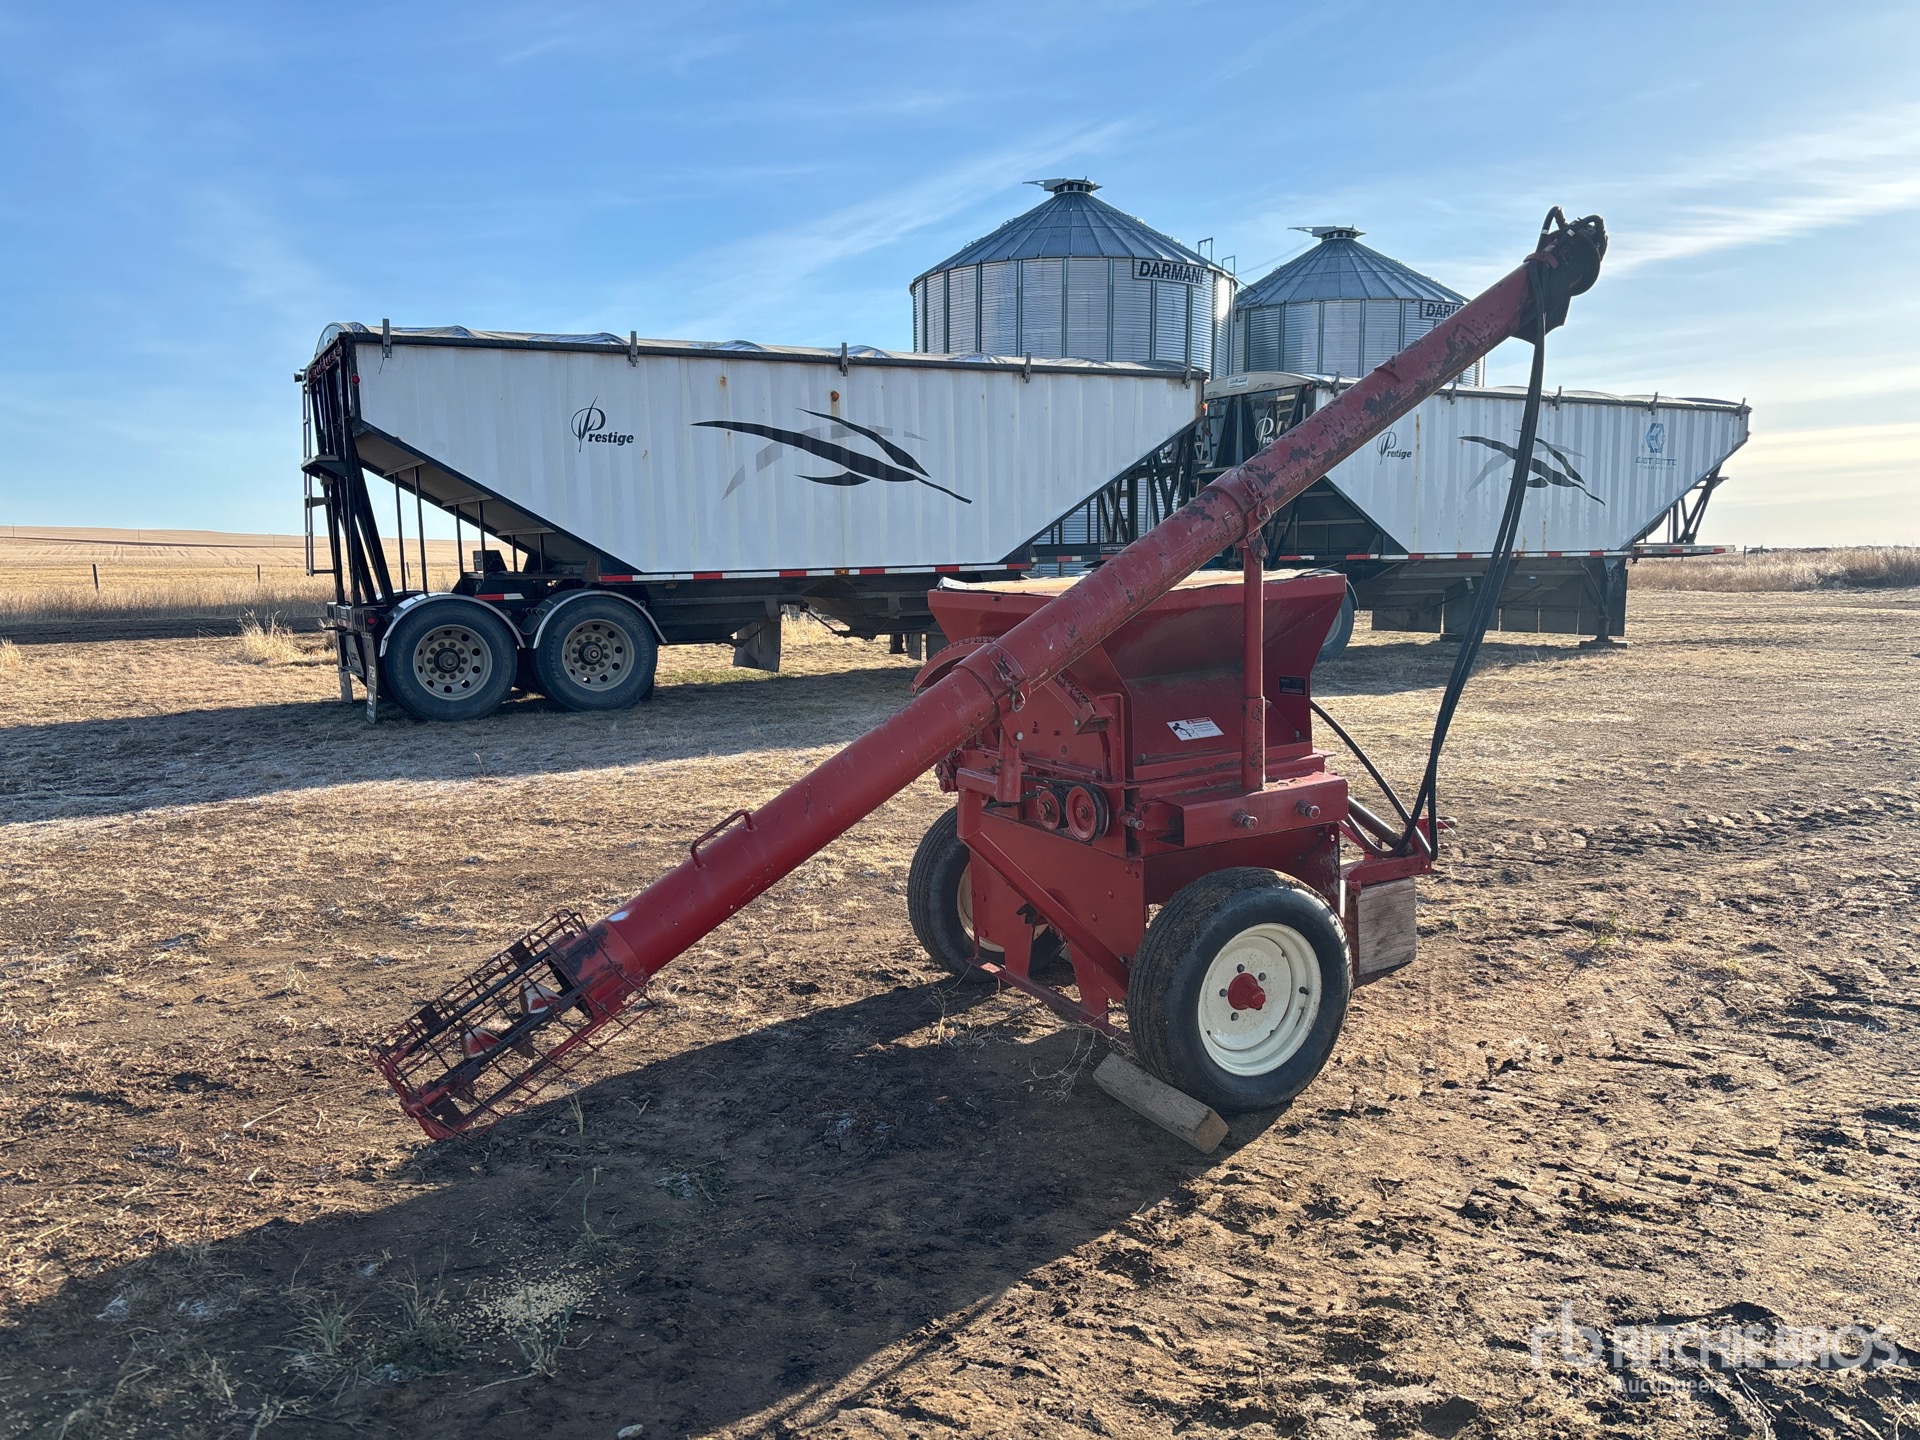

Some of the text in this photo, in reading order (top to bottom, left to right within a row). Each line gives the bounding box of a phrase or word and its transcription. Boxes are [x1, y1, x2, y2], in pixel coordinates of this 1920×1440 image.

[1138, 260, 1204, 284] DARMANI
[571, 395, 634, 453] Prestige
[1377, 424, 1412, 466] Prestige
